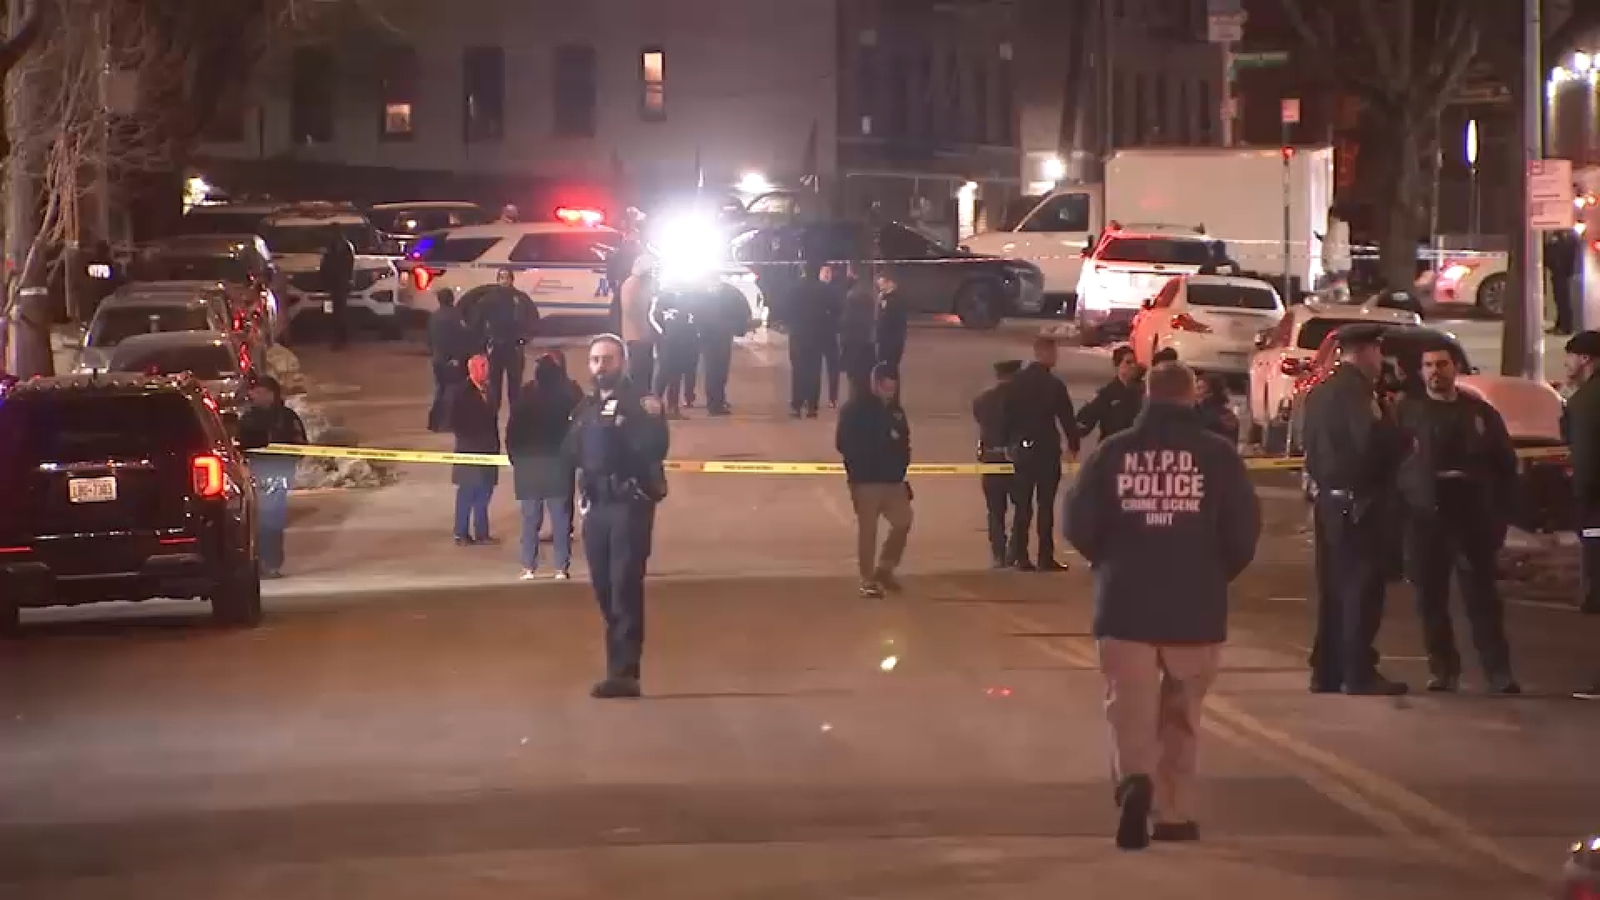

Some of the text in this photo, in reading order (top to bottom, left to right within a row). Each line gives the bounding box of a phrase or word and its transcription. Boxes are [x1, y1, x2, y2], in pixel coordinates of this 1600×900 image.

[1124, 450, 1199, 472] N.Y.P.D.
[1117, 473, 1204, 498] POLICE
[1162, 498, 1200, 511] SCENE
[1146, 512, 1174, 525] UNIT
